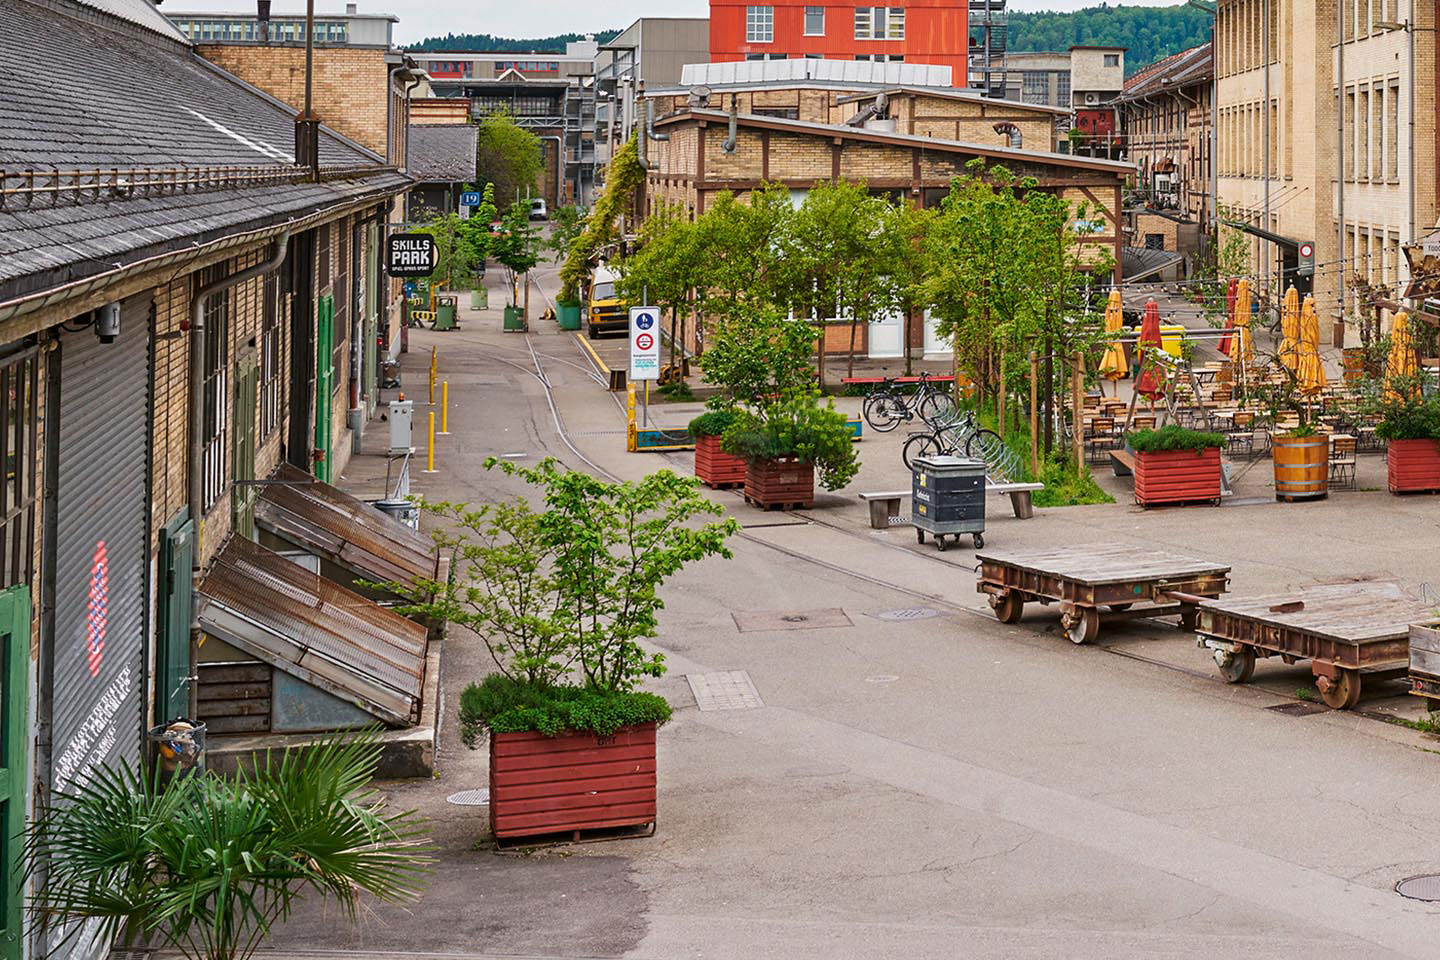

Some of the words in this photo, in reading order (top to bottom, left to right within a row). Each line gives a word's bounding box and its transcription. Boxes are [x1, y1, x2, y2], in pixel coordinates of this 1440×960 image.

[465, 194, 477, 203] 19
[392, 239, 430, 250] SKILLS
[392, 251, 430, 265] PARK
